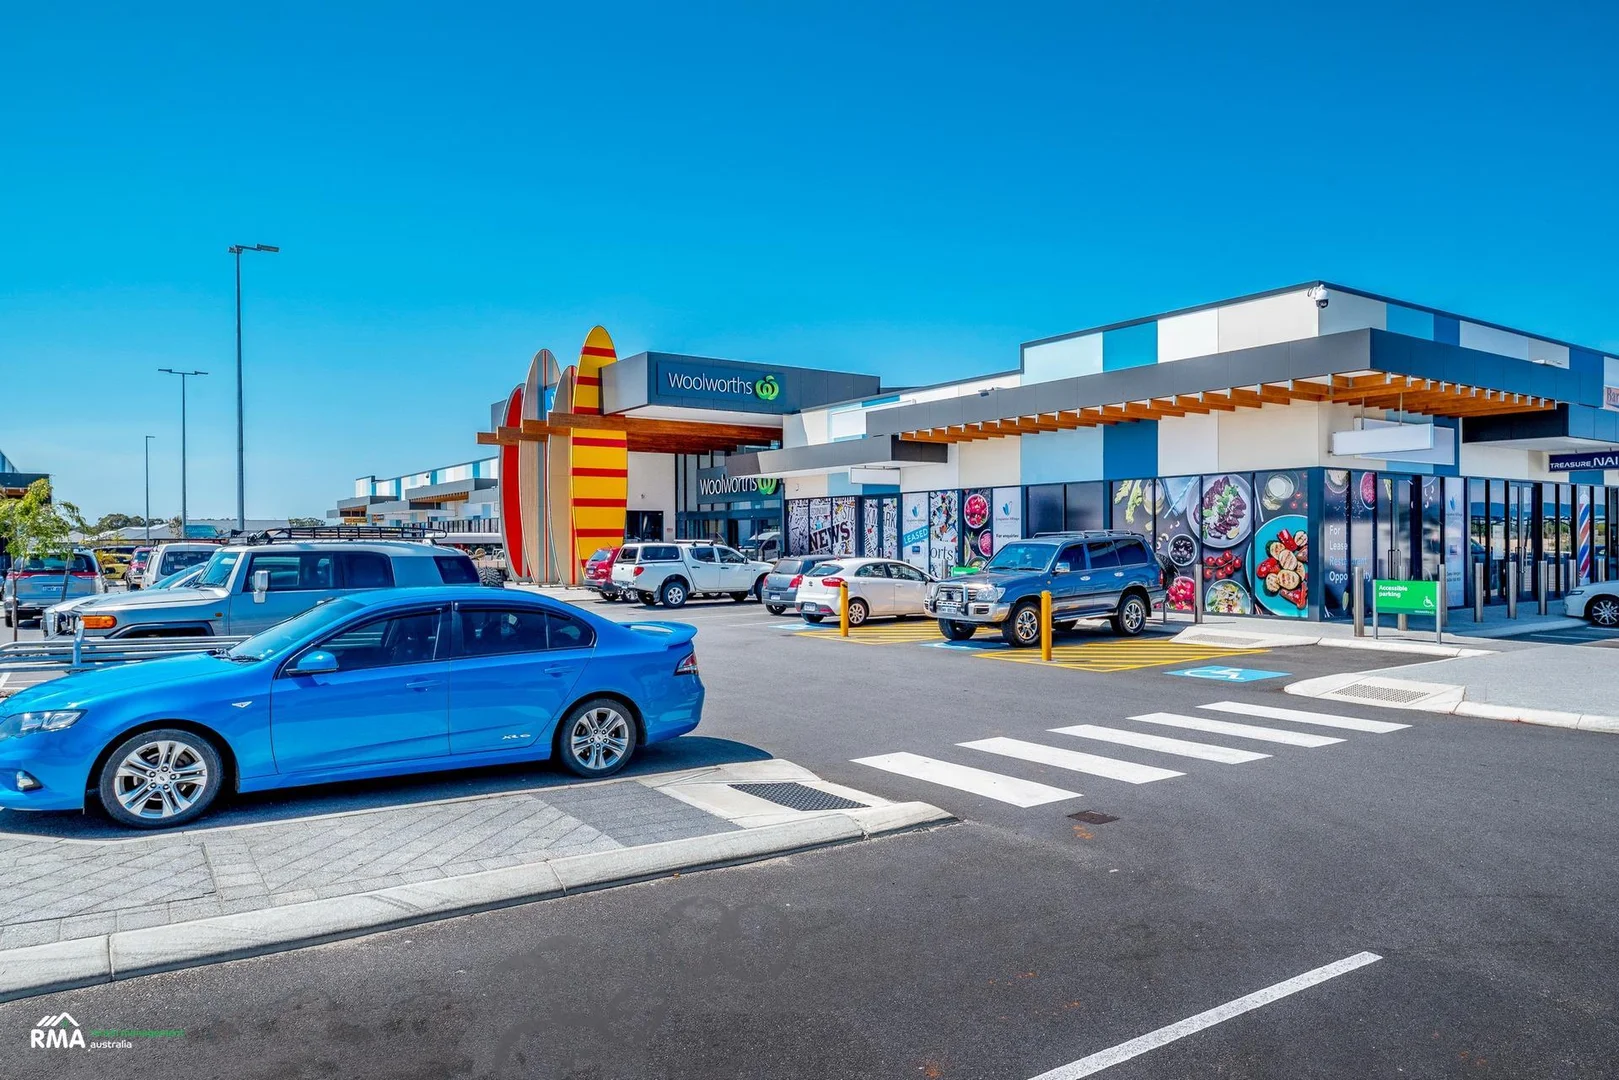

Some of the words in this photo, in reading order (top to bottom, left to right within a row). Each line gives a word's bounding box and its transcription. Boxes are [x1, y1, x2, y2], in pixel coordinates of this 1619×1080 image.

[668, 372, 752, 394] Woolworths
[1550, 461, 1591, 469] TREASURE
[700, 474, 757, 495] Woolworths
[809, 521, 851, 552] NEWS
[904, 528, 928, 544] LEASED
[1329, 525, 1341, 535] For
[1329, 541, 1348, 551] Lease
[1329, 571, 1371, 584] Oppoity
[1379, 591, 1401, 599] parking
